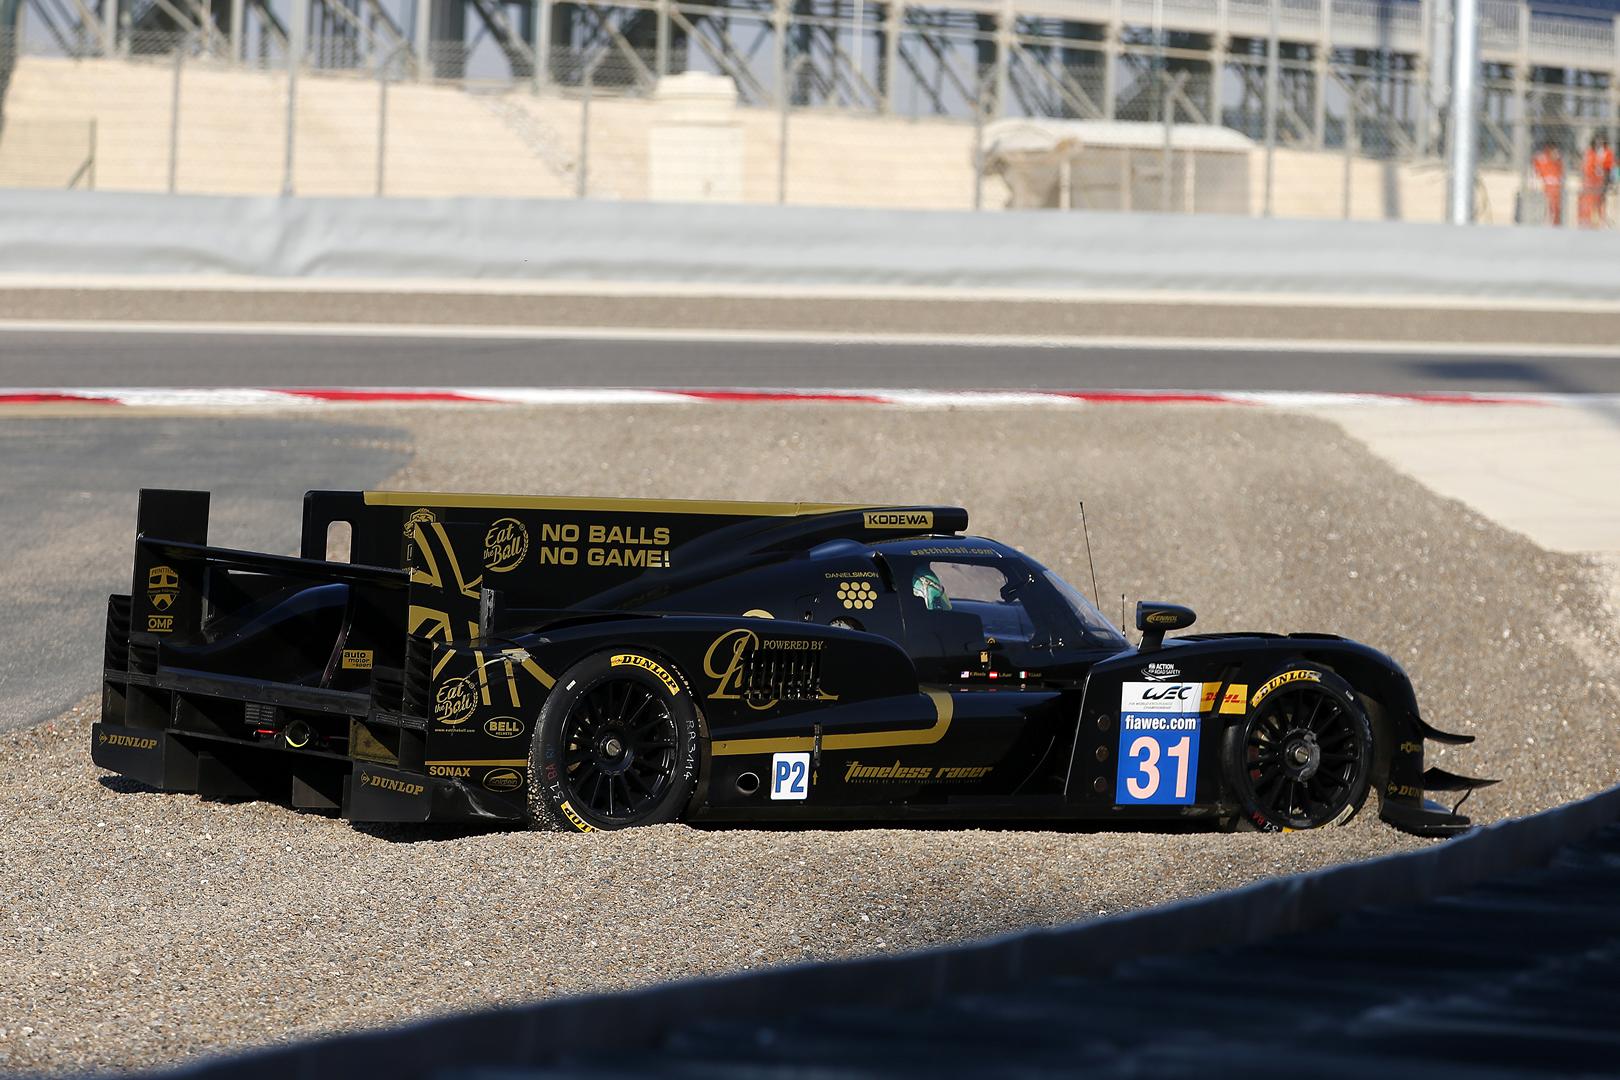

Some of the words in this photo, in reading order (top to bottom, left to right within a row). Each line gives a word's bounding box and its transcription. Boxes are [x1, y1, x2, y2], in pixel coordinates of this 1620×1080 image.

[868, 514, 929, 525] KODEWA
[484, 523, 514, 548] Eat
[541, 523, 580, 543] NO
[588, 525, 670, 545] BALLS
[483, 549, 494, 560] the
[540, 546, 579, 566] NO
[587, 547, 671, 568] GAME!
[147, 618, 174, 630] OMP
[763, 640, 810, 650] POWERED
[811, 640, 824, 650] BY
[344, 651, 366, 659] auto
[621, 655, 677, 690] DUNLOP
[436, 681, 465, 703] Eat
[1141, 685, 1193, 701] WEC
[489, 721, 520, 732] BELL
[1125, 715, 1197, 730] fiawec.com
[108, 734, 158, 750] DUNLOP
[429, 766, 471, 777] SONAX
[843, 759, 934, 783] timeless
[935, 765, 994, 779] racer
[1126, 736, 1191, 800] 31
[774, 760, 806, 794] P2
[370, 775, 424, 796] DUNLOP
